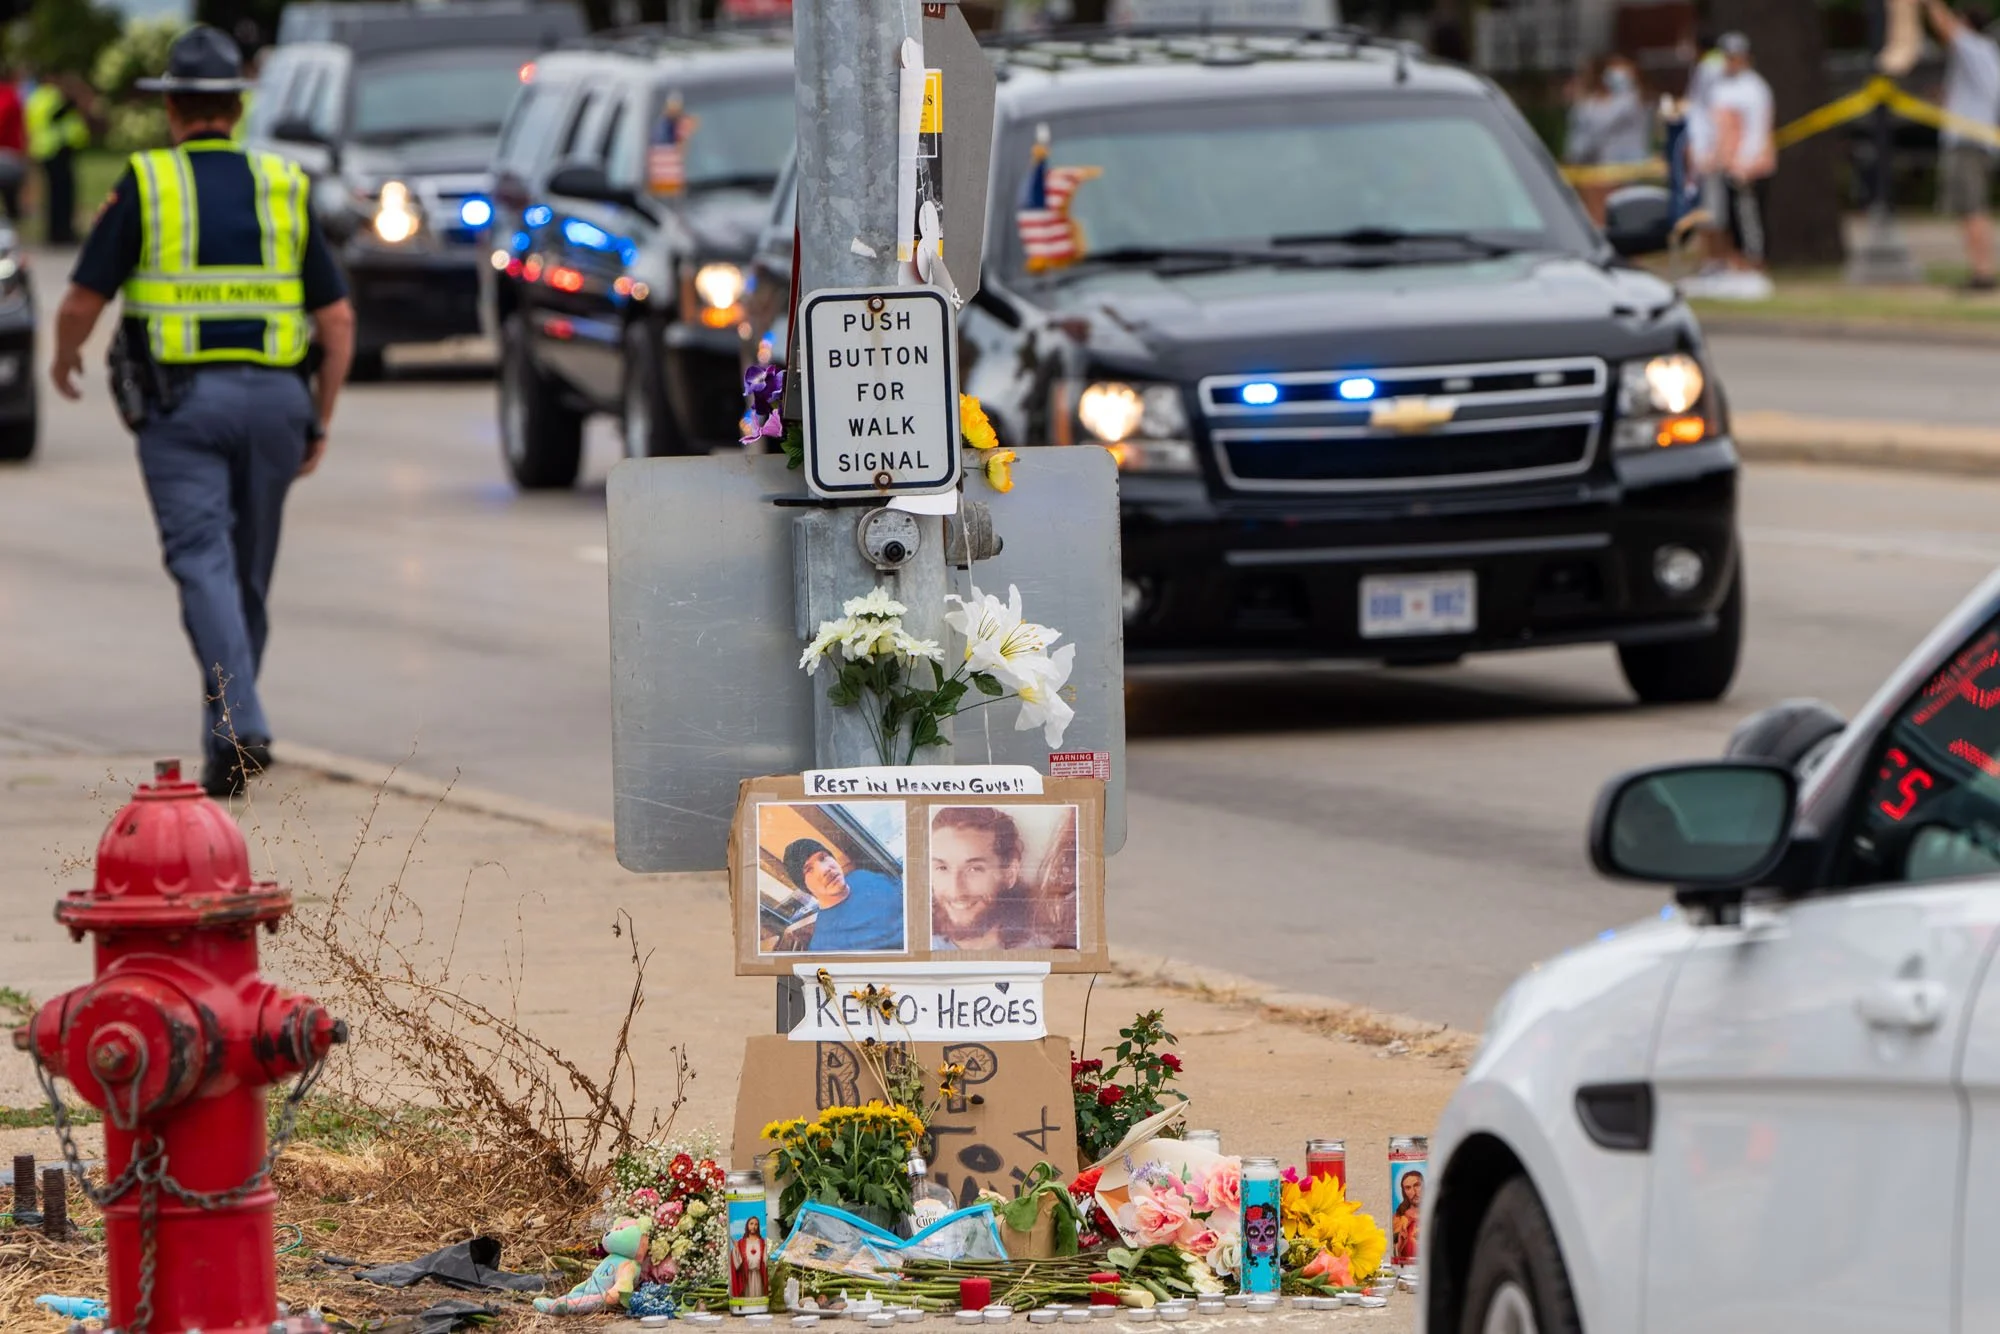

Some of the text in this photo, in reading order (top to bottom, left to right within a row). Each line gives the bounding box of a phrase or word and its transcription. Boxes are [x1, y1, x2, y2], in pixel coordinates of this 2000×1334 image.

[174, 282, 278, 301] STATE PATROL
[844, 311, 911, 332] PUSH
[829, 346, 928, 368] BUTTON
[857, 382, 905, 402] FOR
[848, 416, 915, 437] WALK
[838, 450, 929, 473] SIGNAL
[813, 774, 860, 793] REST
[938, 988, 1038, 1029] HEROES
